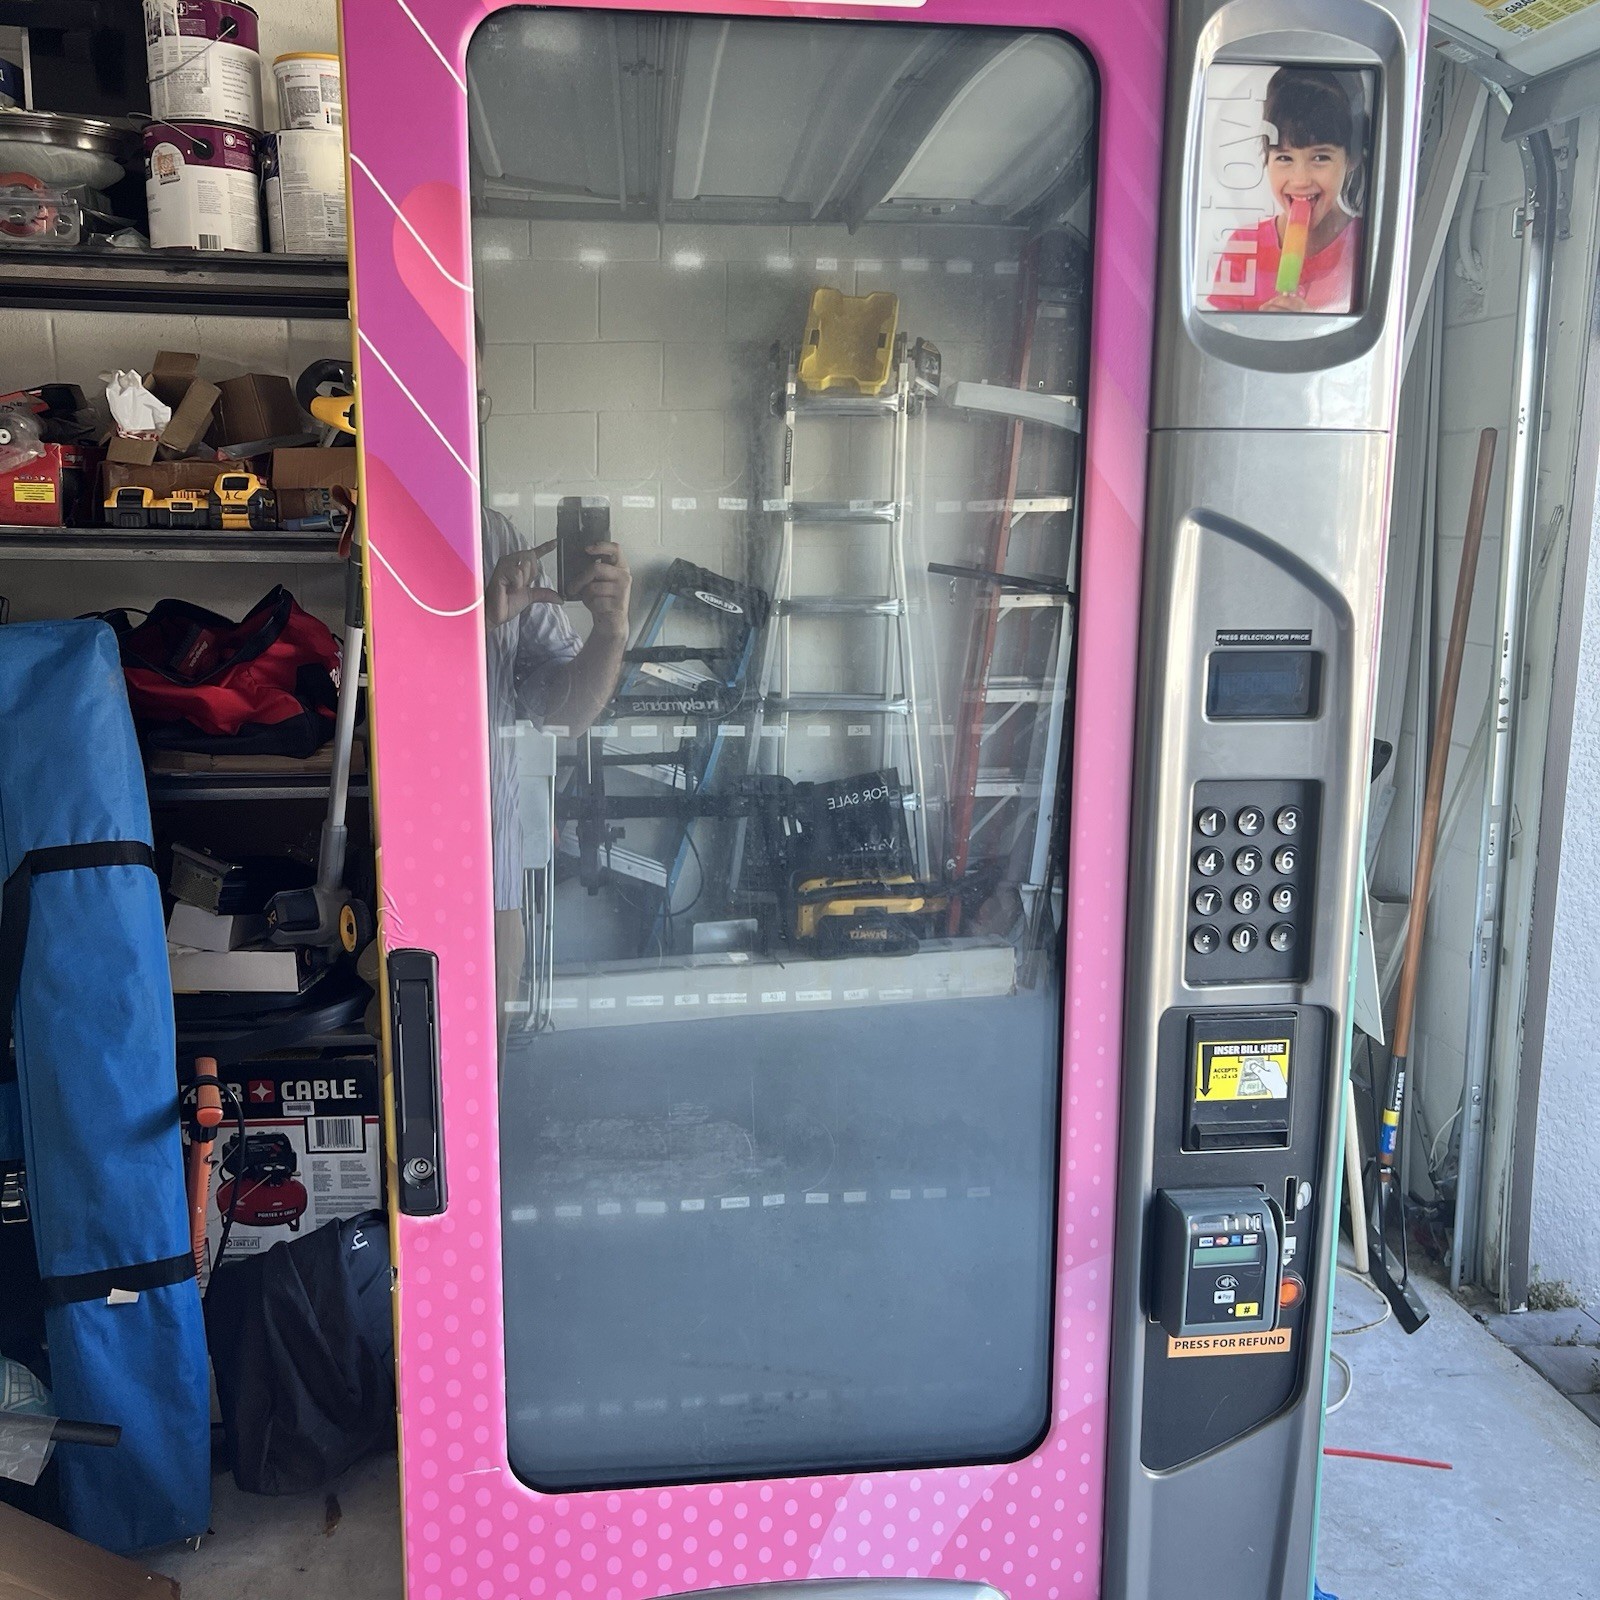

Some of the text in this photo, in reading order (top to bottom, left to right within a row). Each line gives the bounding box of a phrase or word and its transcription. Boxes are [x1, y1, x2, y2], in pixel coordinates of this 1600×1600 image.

[1217, 633, 1310, 641] PRESS SELECTION FOR PRICE
[1208, 812, 1297, 832] 1 2 3
[1204, 851, 1294, 871] 4 5 6
[1204, 889, 1292, 912] 7 8 9
[1239, 929, 1250, 948] 0
[1213, 1043, 1284, 1055] INSER BILL HERE
[1243, 1305, 1251, 1314] #
[1174, 1336, 1285, 1350] PRESS FOR REFUND
